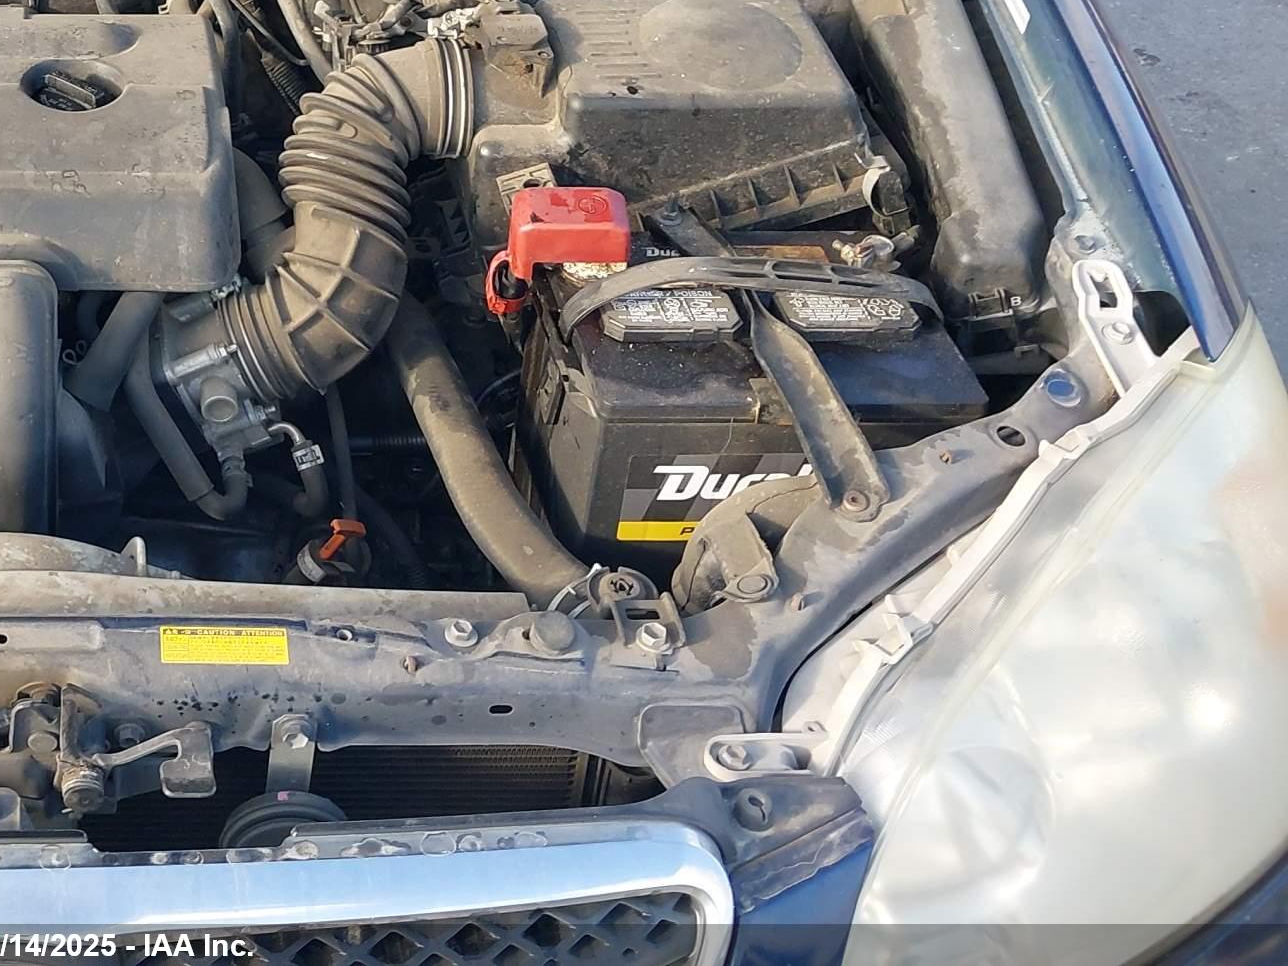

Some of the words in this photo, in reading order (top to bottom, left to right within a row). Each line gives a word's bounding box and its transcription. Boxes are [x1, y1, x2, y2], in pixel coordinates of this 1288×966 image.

[1010, 296, 1022, 307] B
[197, 628, 236, 636] CAUTION
[241, 629, 283, 637] ATTENTION
